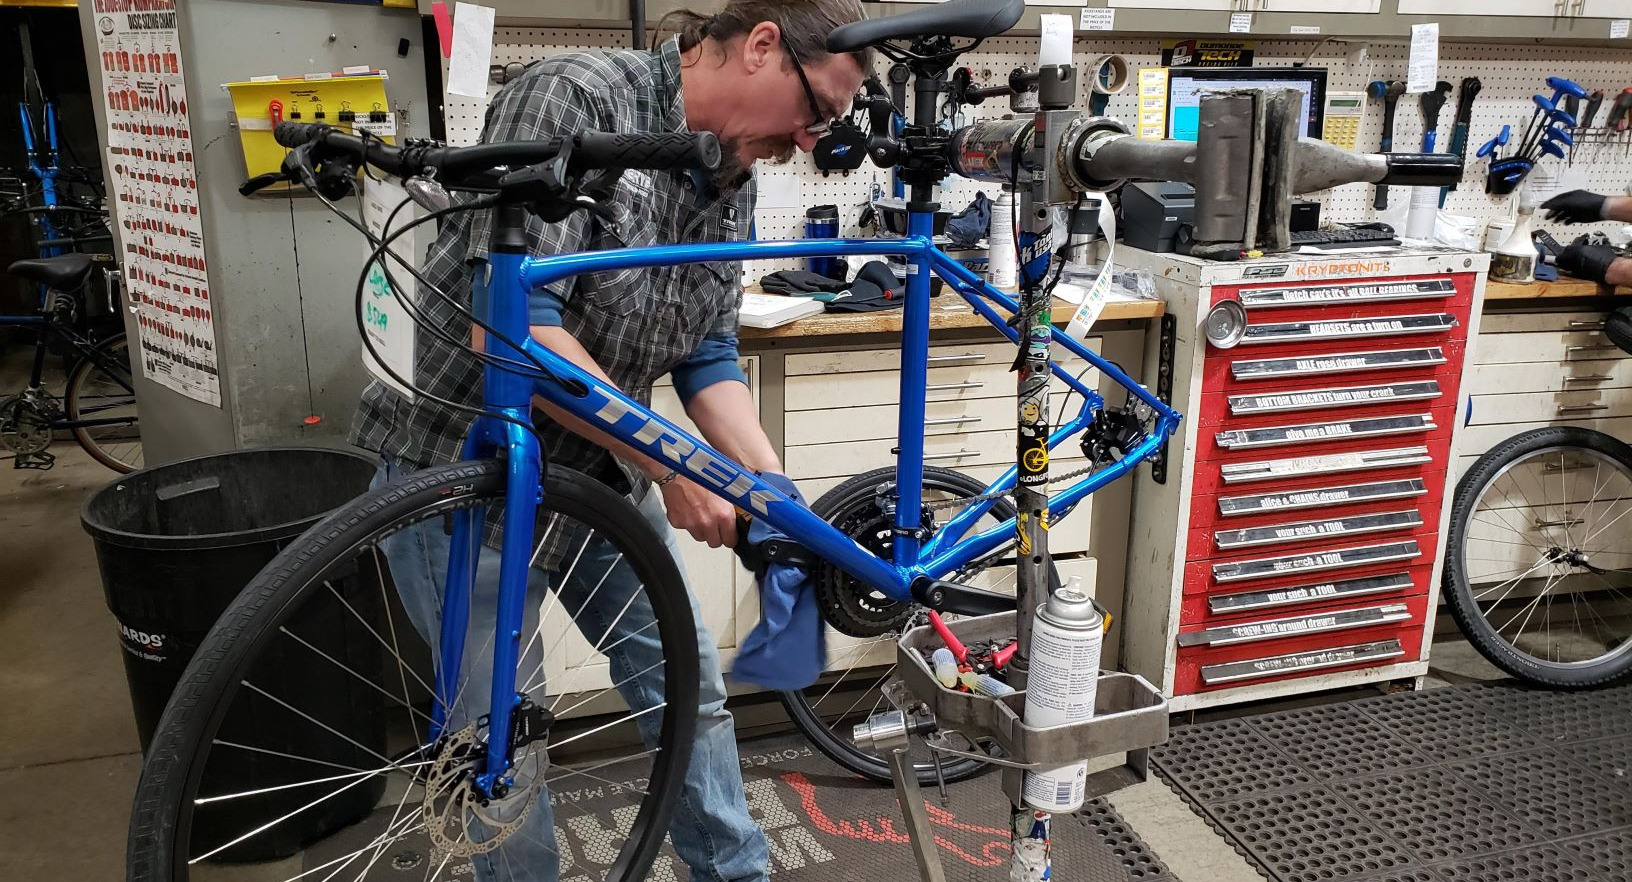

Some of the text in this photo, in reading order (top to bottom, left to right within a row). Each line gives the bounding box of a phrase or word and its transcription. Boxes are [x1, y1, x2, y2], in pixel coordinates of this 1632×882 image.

[1336, 357, 1366, 368] drawer
[1256, 396, 1291, 408] BOTTOM
[1292, 392, 1333, 405] BRACKETS
[1305, 429, 1319, 438] me
[1326, 424, 1352, 436] BRAKE
[593, 385, 786, 516] TREK
[1260, 497, 1282, 508] alice
[1320, 490, 1349, 502] drawer
[1319, 525, 1324, 533] a
[1324, 522, 1345, 532] TOOL
[1322, 553, 1343, 564] TOOL
[1316, 584, 1337, 596] TOOL
[1278, 620, 1307, 633] around
[1307, 617, 1336, 629] drawer
